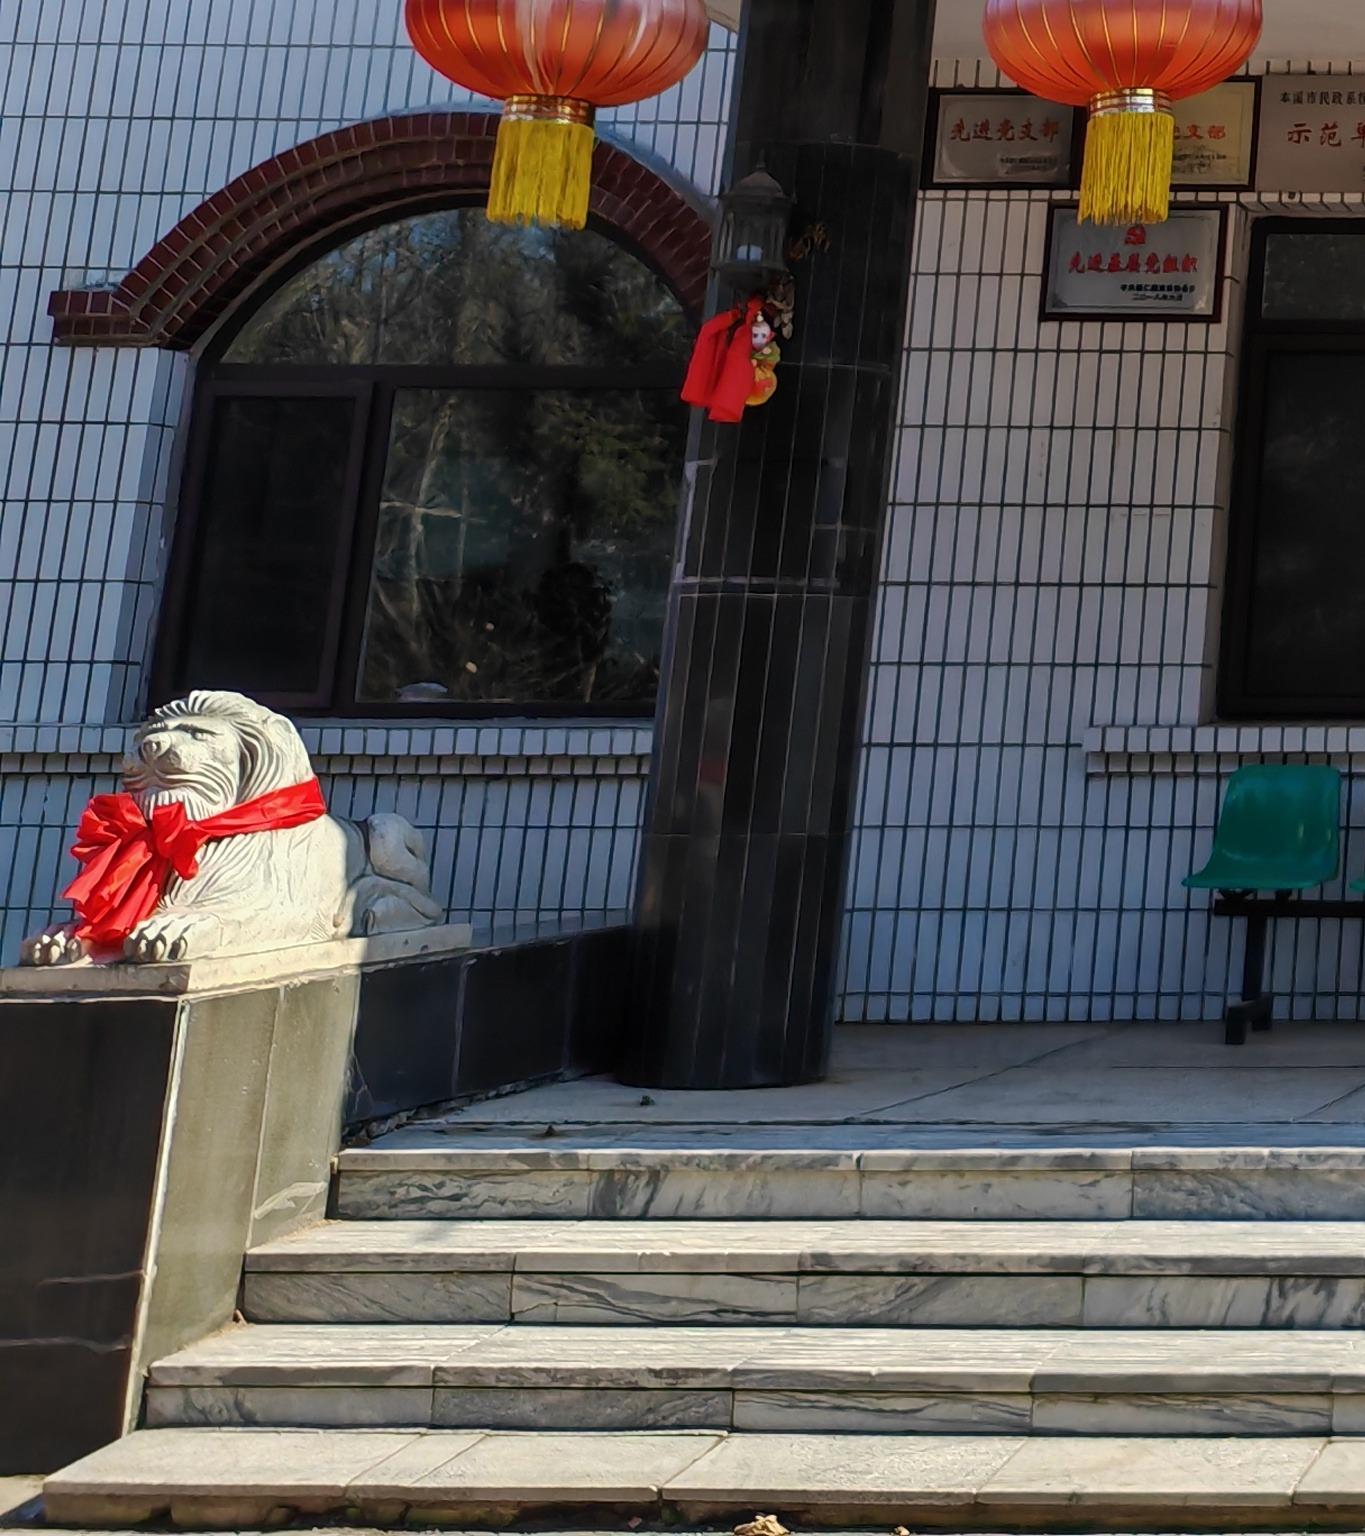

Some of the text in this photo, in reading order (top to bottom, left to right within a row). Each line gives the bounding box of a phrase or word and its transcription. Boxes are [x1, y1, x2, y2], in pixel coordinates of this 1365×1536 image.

[949, 116, 1062, 143] 先进党支部
[1174, 123, 1227, 140] 支部
